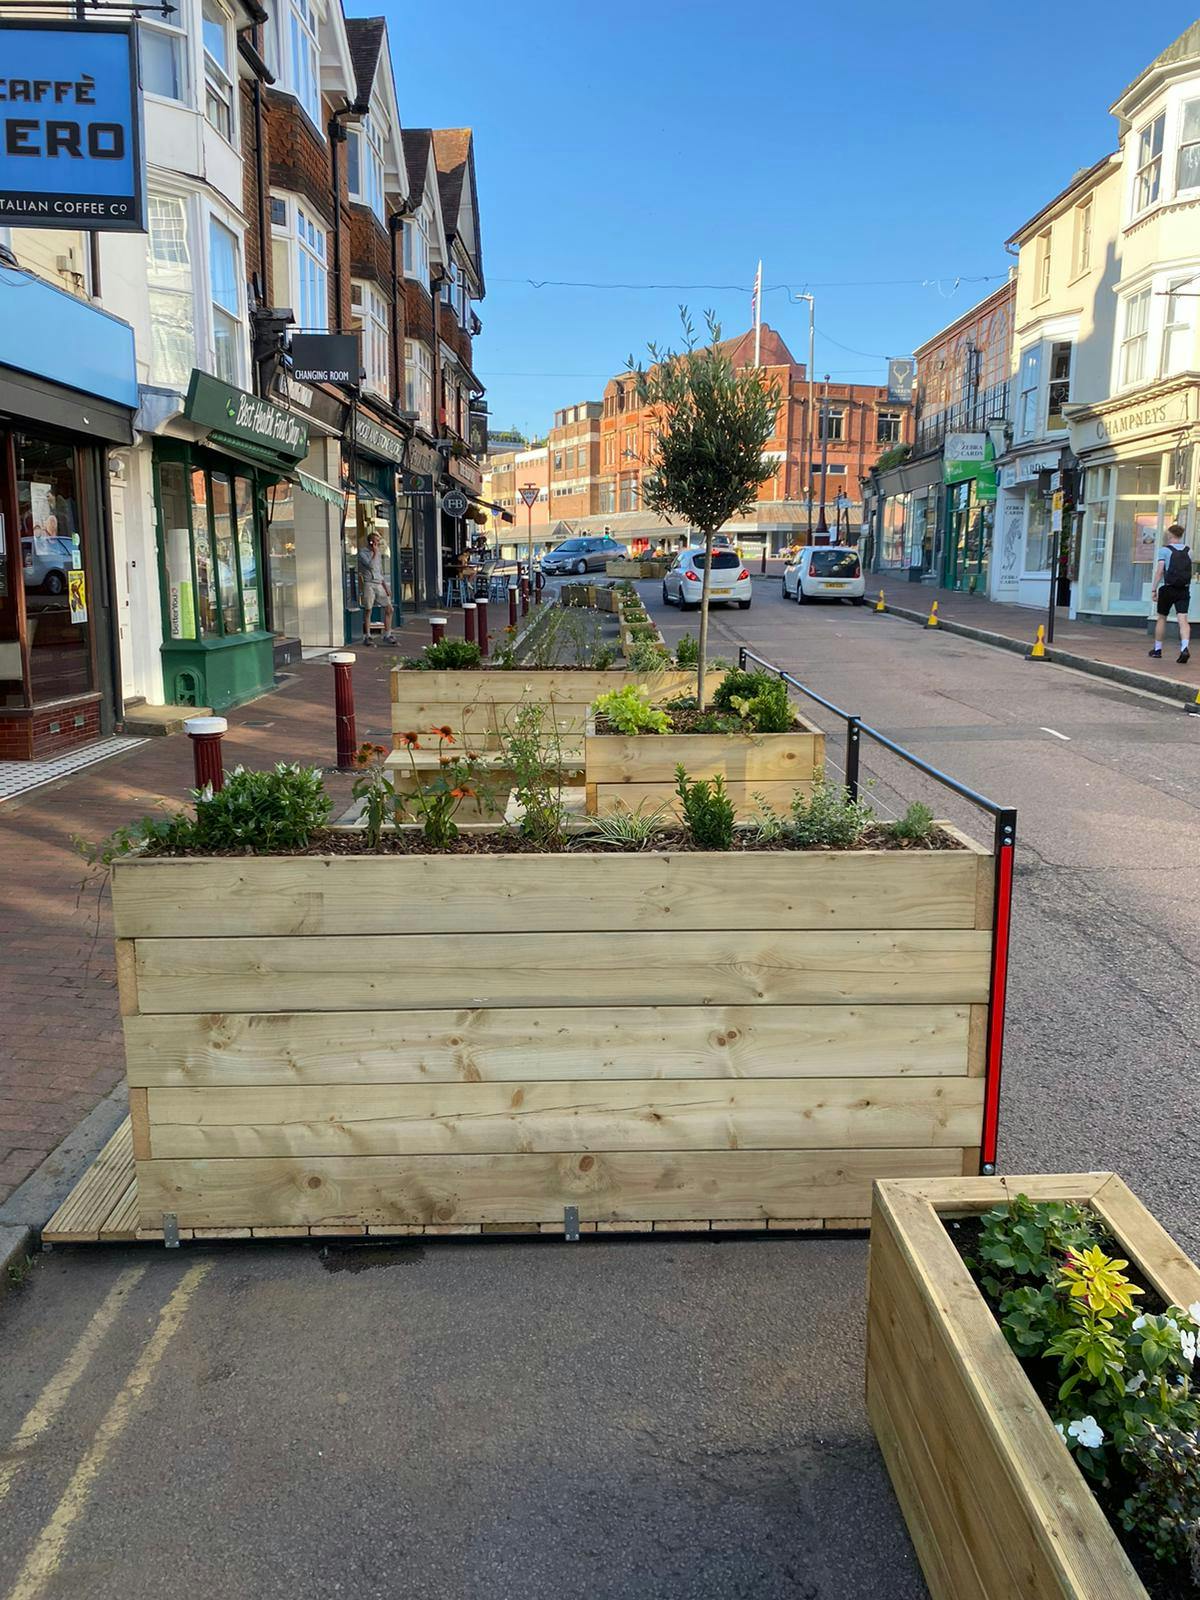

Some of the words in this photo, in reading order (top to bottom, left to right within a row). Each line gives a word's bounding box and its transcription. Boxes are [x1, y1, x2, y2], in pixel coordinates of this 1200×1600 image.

[4, 118, 125, 160] ERO
[0, 199, 48, 212] TALIAN
[54, 201, 105, 214] COFFEE
[294, 369, 328, 380] CHANGING
[329, 370, 349, 381] ROOM
[236, 393, 255, 428] Best
[252, 402, 275, 437] Health
[272, 412, 290, 441] Food
[1096, 404, 1167, 439] CHAMPNEYS
